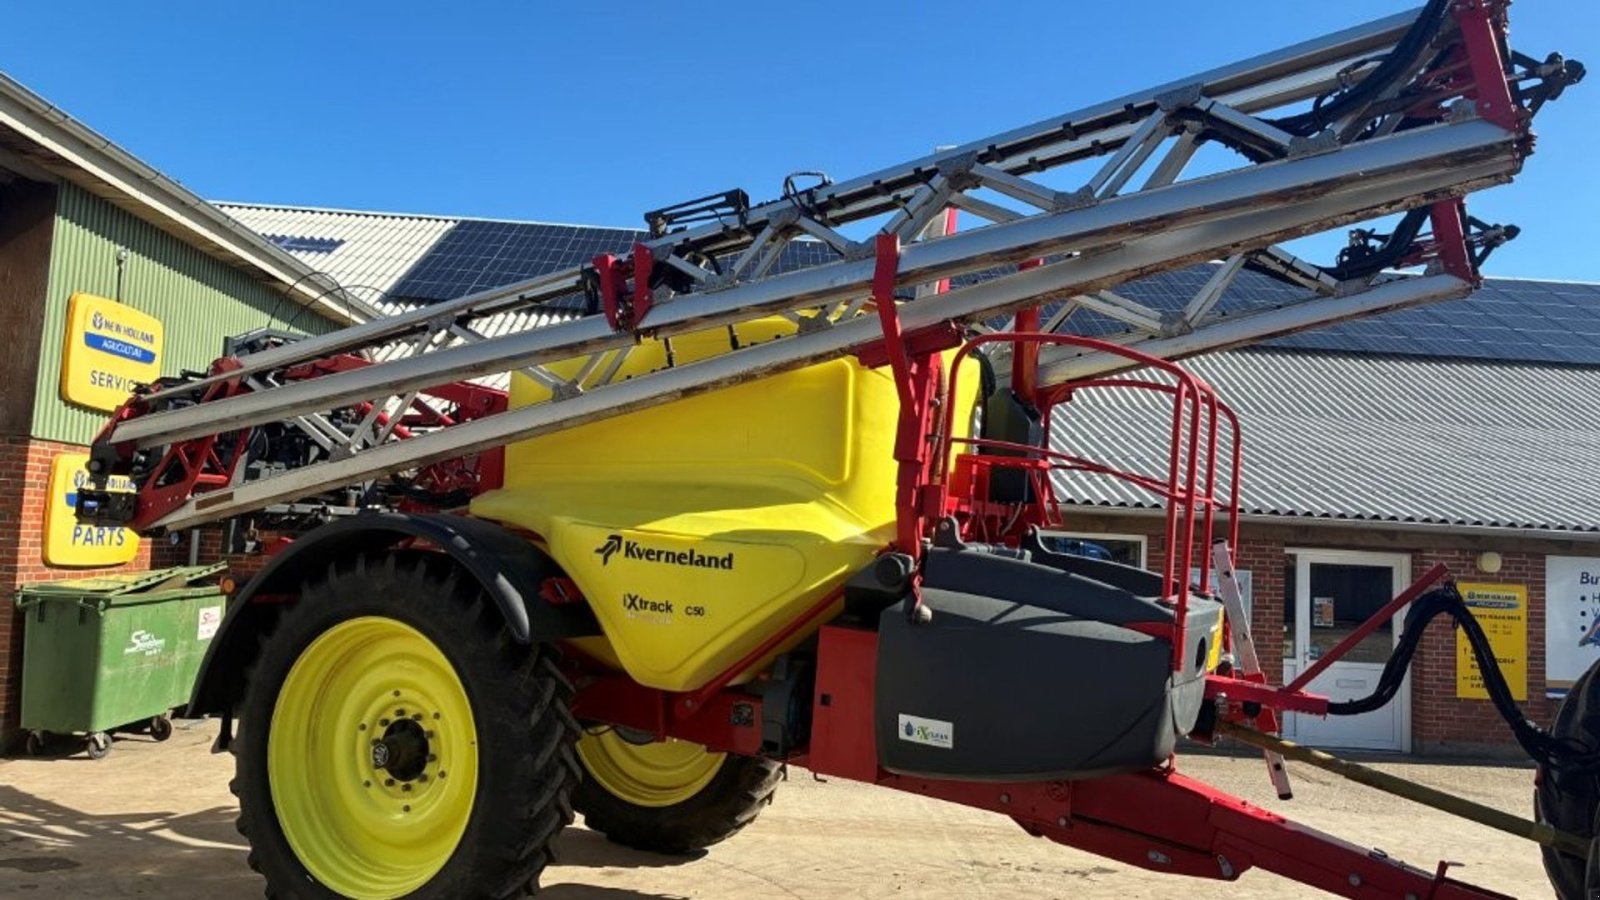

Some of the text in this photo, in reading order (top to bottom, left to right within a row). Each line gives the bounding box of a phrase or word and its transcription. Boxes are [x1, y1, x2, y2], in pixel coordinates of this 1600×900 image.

[104, 318, 154, 345] NEW HOLLAND
[90, 369, 137, 394] SERVIC
[72, 525, 125, 546] PARTS
[624, 540, 734, 570] Kverneland
[623, 592, 705, 617] iXtrack C50
